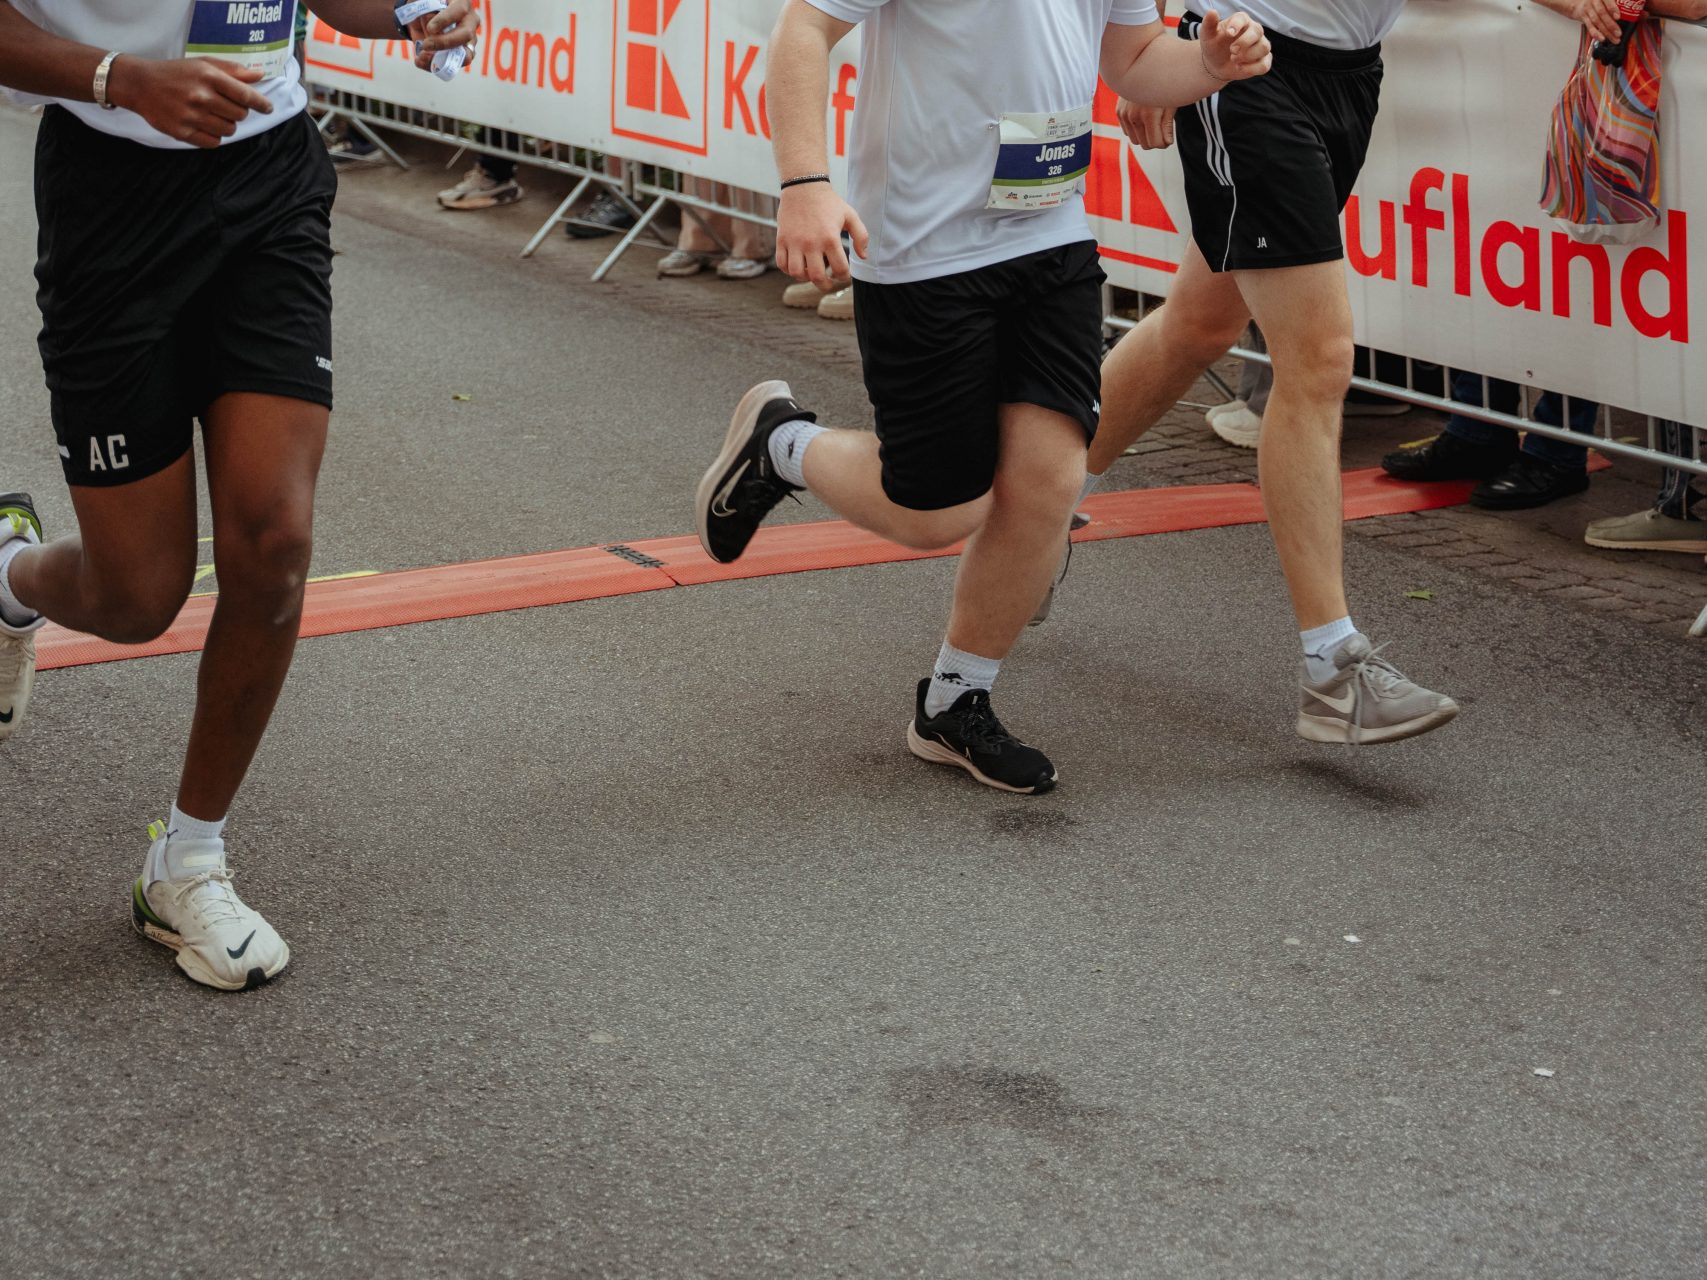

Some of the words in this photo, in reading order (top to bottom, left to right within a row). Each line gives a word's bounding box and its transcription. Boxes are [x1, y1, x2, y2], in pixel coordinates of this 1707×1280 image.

[226, 0, 283, 24] Michael
[248, 29, 265, 42] 203
[1035, 143, 1076, 163] Jonas
[1047, 164, 1063, 176] 326
[1257, 237, 1268, 248] JA
[1345, 167, 1689, 344] ufland
[90, 434, 130, 471] AC
